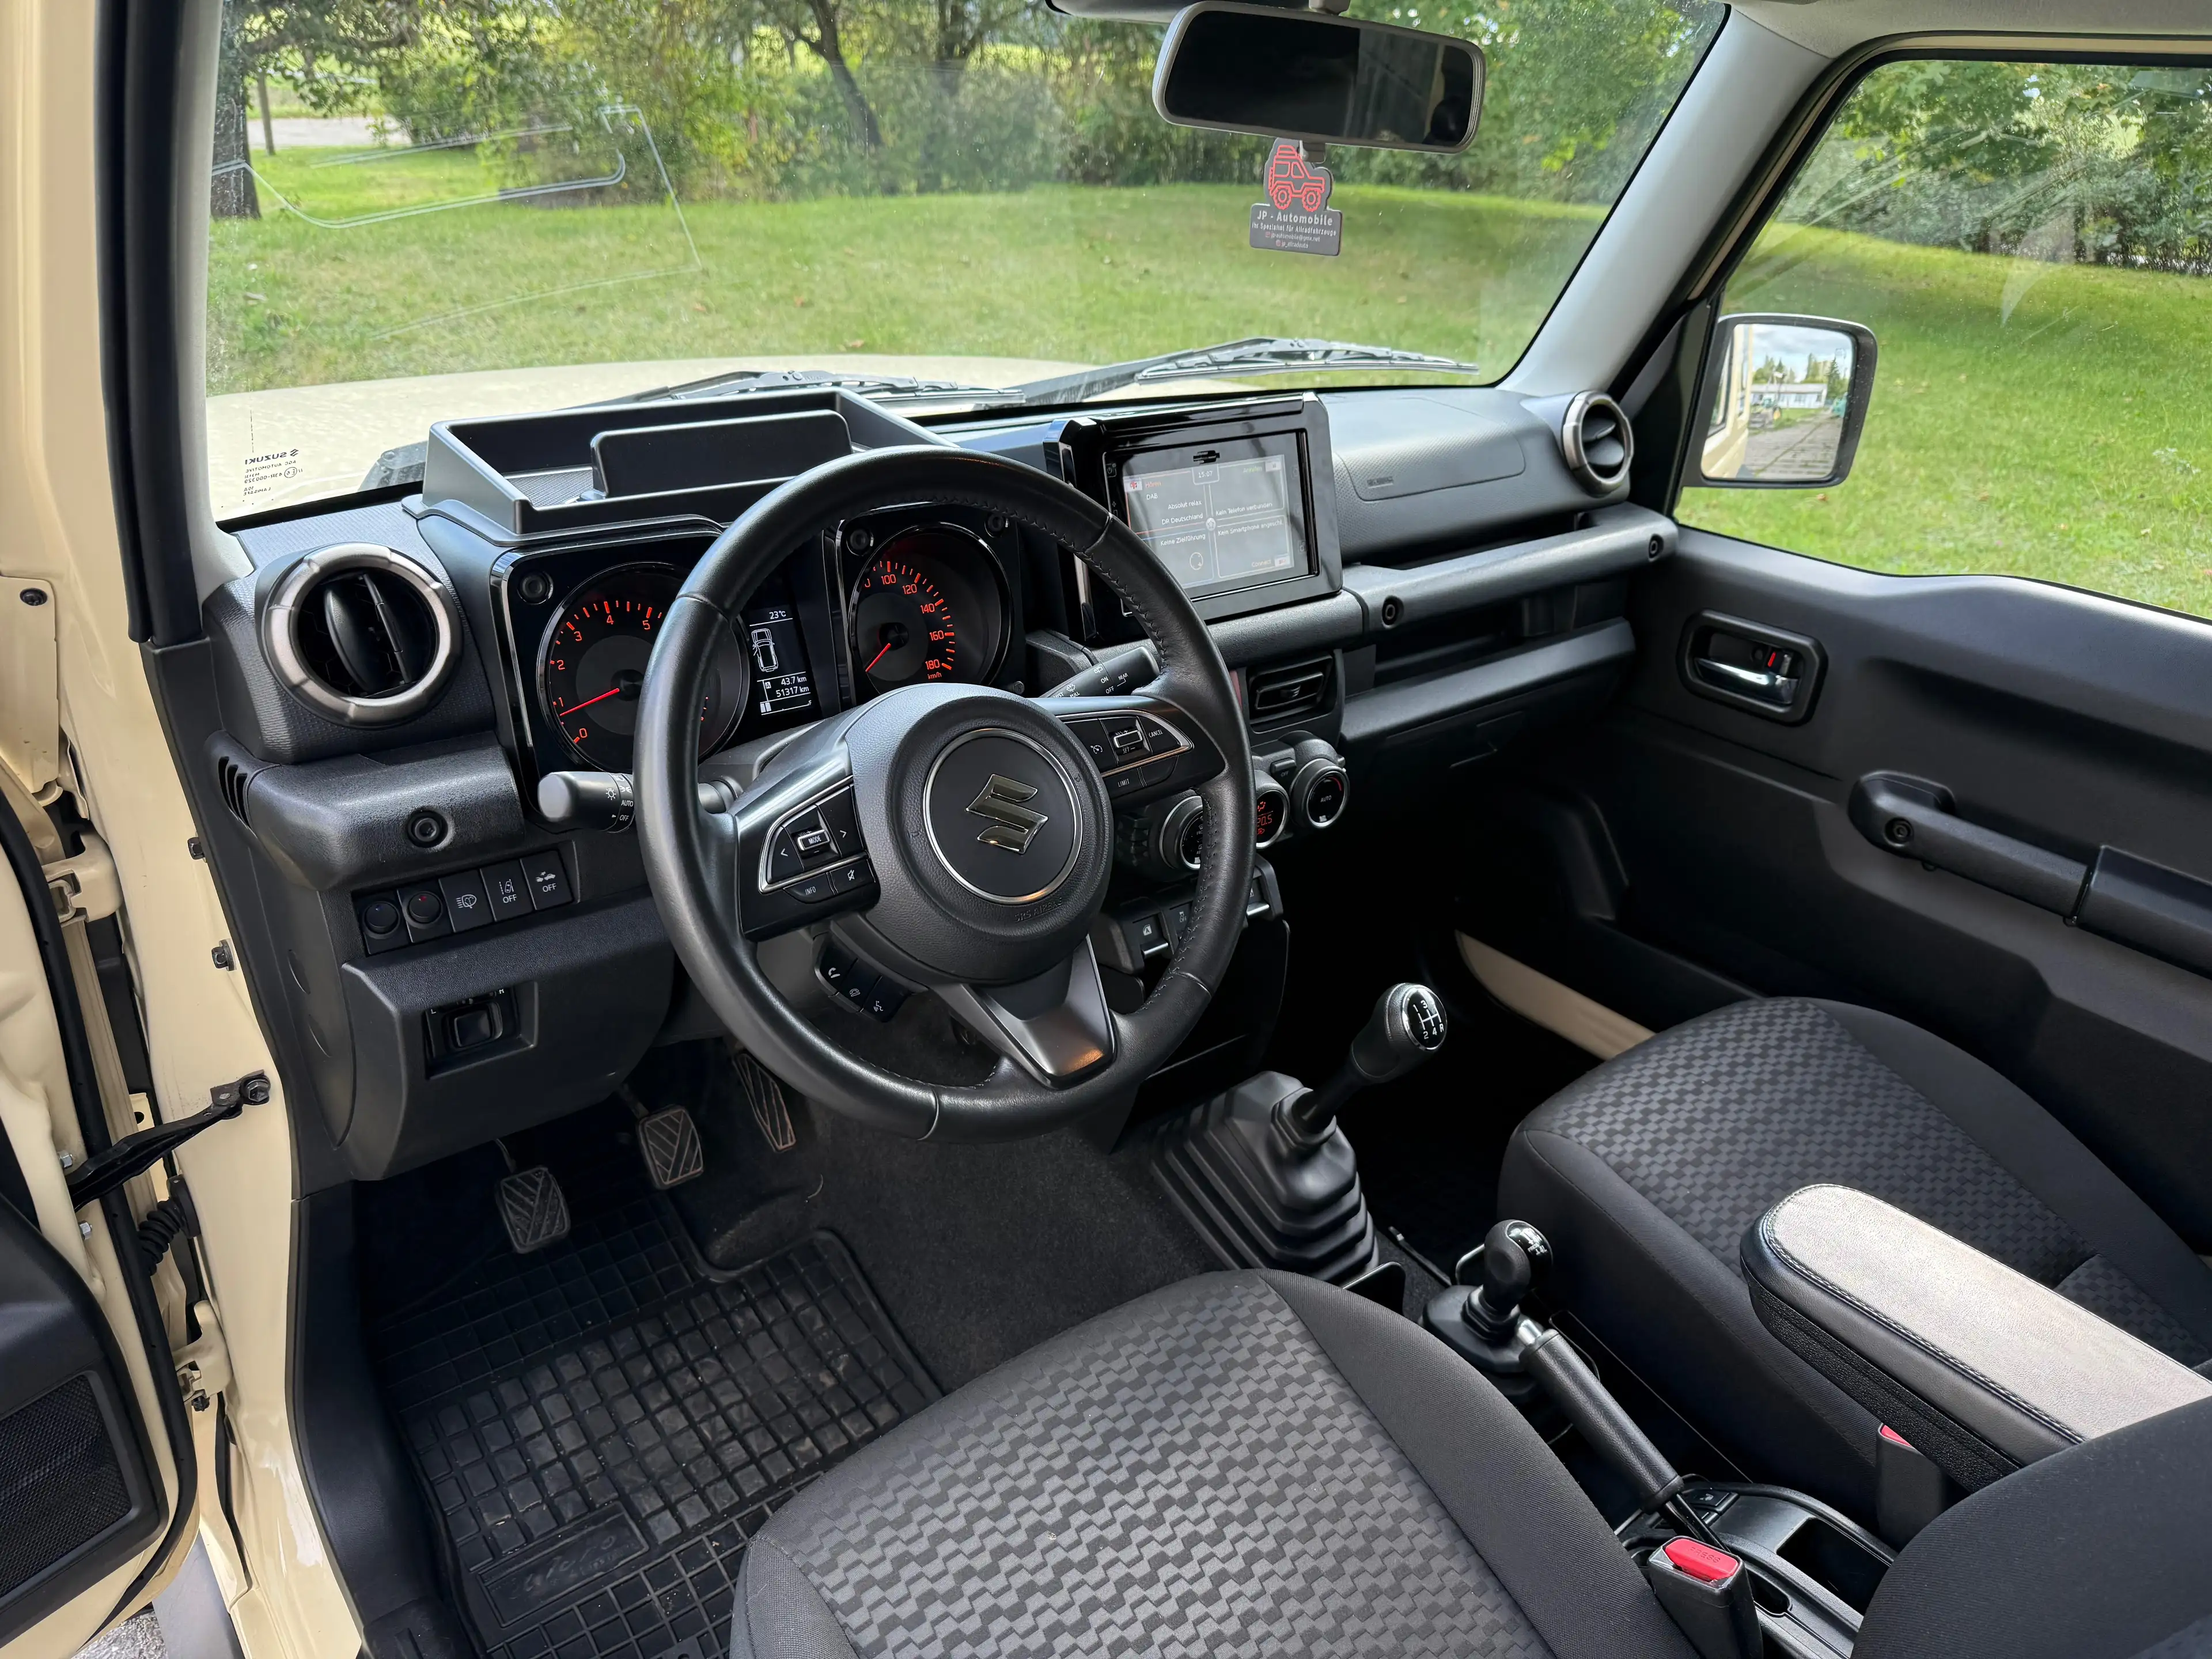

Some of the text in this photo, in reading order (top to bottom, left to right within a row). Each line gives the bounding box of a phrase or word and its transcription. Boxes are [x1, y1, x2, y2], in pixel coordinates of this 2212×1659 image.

[1257, 210, 1267, 220] JP
[1277, 211, 1333, 226] Automobile
[1260, 222, 1285, 232] Spezialist
[1286, 224, 1294, 232] für
[1295, 225, 1336, 237] Allradfahrzeuge
[1198, 470, 1213, 478] 15:07
[1145, 480, 1161, 488] Hören
[1168, 501, 1188, 510] Absolut
[1228, 506, 1246, 514] Telefon
[1246, 501, 1272, 511] verbunden
[1171, 513, 1203, 524] Deutschland
[1218, 528, 1229, 536] Kein
[1230, 524, 1260, 535] Smartphone
[1176, 533, 1206, 544] Zielführung
[881, 574, 896, 585] 100
[902, 584, 917, 594] 120
[921, 603, 935, 614] 140
[607, 615, 614, 625] 4
[769, 611, 786, 620] 23°C
[642, 620, 650, 630] 5
[573, 631, 582, 641] 3
[929, 630, 944, 641] 160
[556, 660, 566, 671] 2
[925, 659, 940, 670] 180
[781, 676, 796, 686] 43.7
[797, 675, 806, 683] km
[927, 671, 942, 680] km/h
[1118, 672, 1129, 681] REAR
[776, 685, 809, 697] 51317 km
[1105, 685, 1115, 695] OFF
[558, 697, 564, 707] 1
[579, 728, 588, 738] 0
[1148, 729, 1163, 738] CANCEL
[1118, 778, 1130, 787] LIMIT
[1320, 794, 1332, 803] AUTO
[808, 835, 821, 844] MODE
[542, 883, 557, 893] OFF
[805, 885, 816, 895] INFO
[502, 894, 517, 904] OFF
[1015, 910, 1031, 922] SRS
[1412, 1004, 1418, 1012] 1
[1421, 999, 1428, 1009] 3
[1433, 1027, 1437, 1035] 4
[1439, 1023, 1444, 1032] R
[1423, 1031, 1429, 1039] 2
[1688, 1546, 1721, 1563] PRESS
